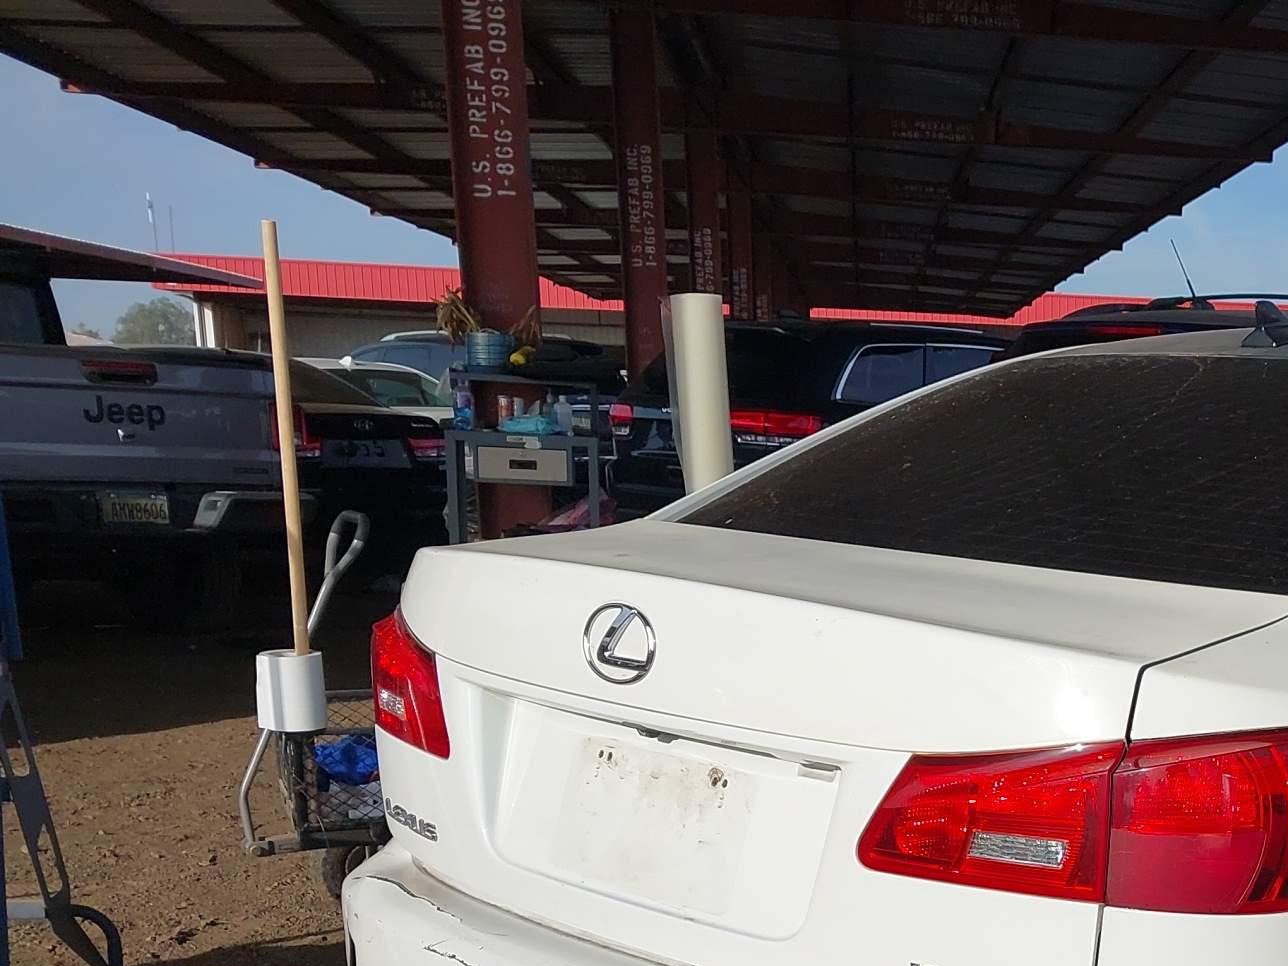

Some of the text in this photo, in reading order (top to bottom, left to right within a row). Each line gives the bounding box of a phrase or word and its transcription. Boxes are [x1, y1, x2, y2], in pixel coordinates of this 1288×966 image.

[464, 43, 489, 139] PREFAB
[486, 0, 517, 196] 1-866-799-096
[472, 153, 492, 198] U.S.
[628, 177, 642, 233] PREFAB
[640, 144, 657, 267] 1-866-799-0969
[82, 395, 166, 431] Jeep
[385, 797, 438, 842] LEXUS
